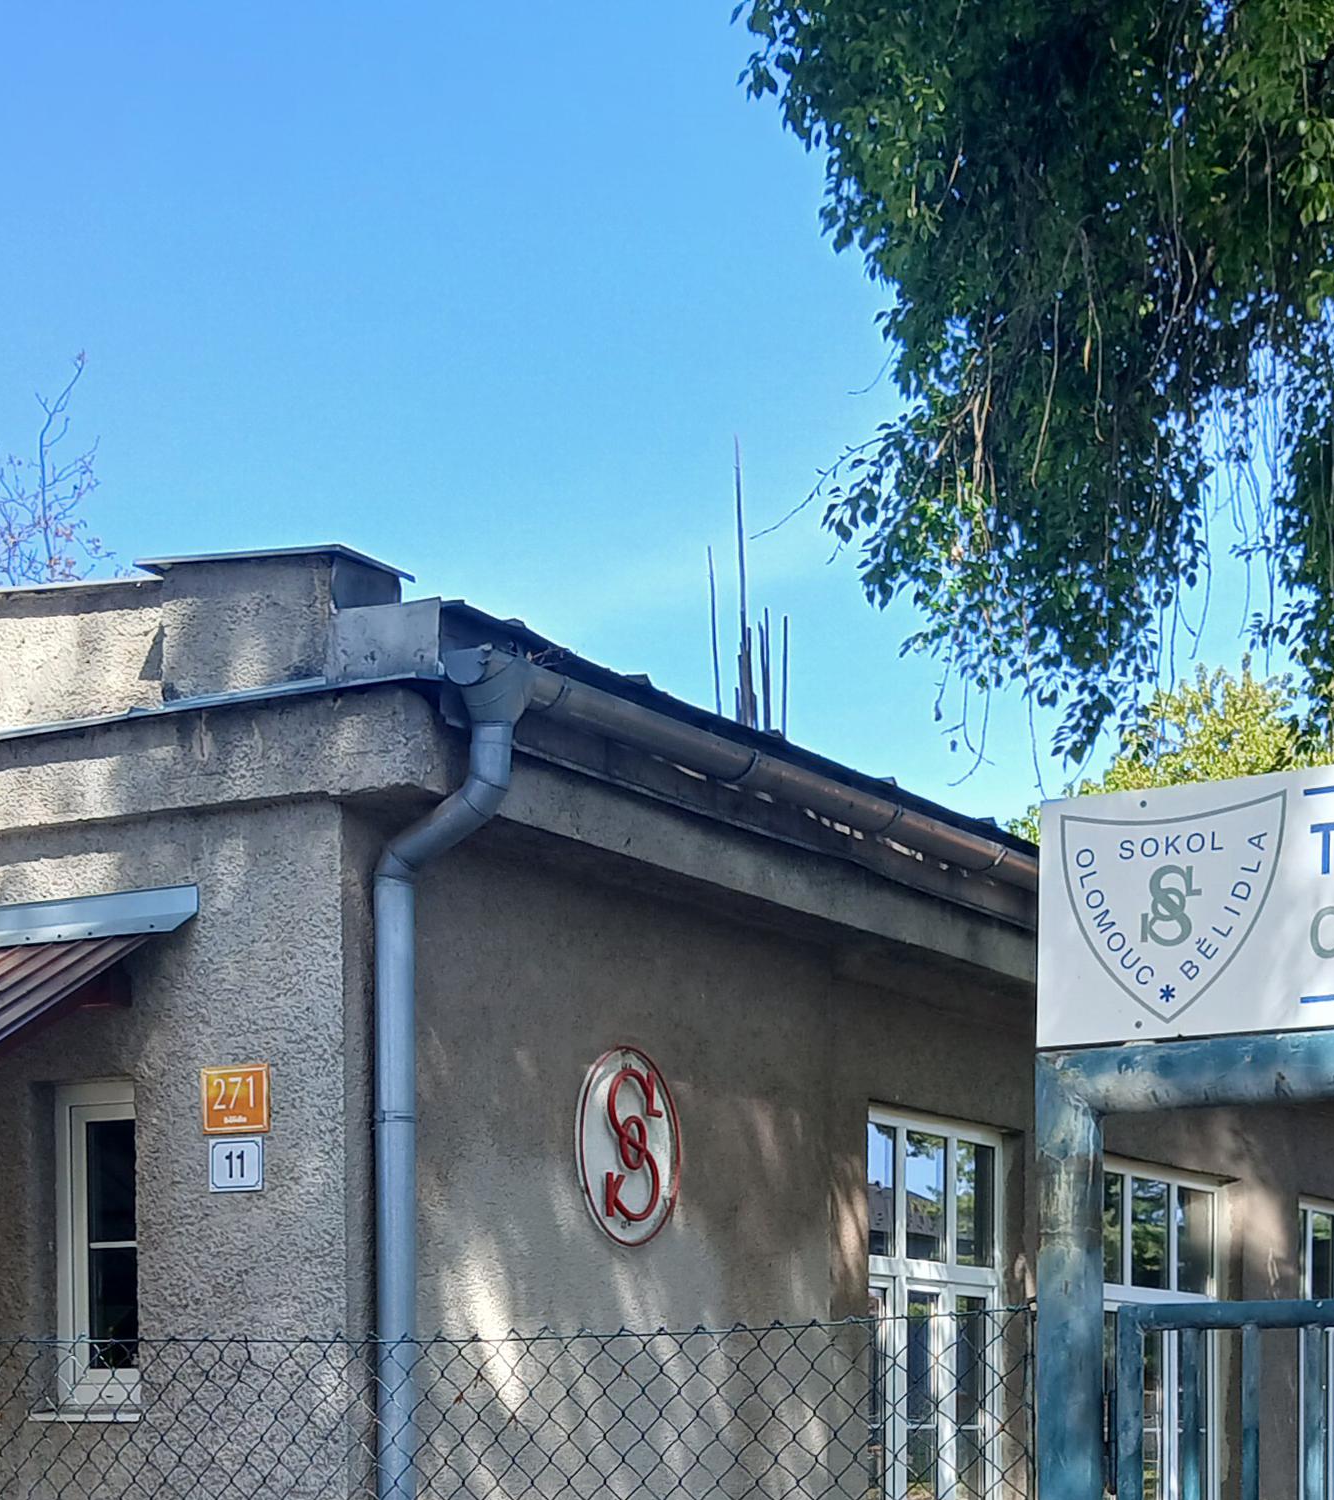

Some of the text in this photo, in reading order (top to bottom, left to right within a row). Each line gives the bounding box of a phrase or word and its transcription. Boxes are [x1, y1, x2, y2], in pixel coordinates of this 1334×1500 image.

[1118, 831, 1224, 860] SOKOL
[1075, 848, 1155, 985] OLOMOUC
[1179, 831, 1268, 981] BĚLIDLA
[212, 1075, 254, 1111] 271
[224, 1150, 245, 1179] 11
